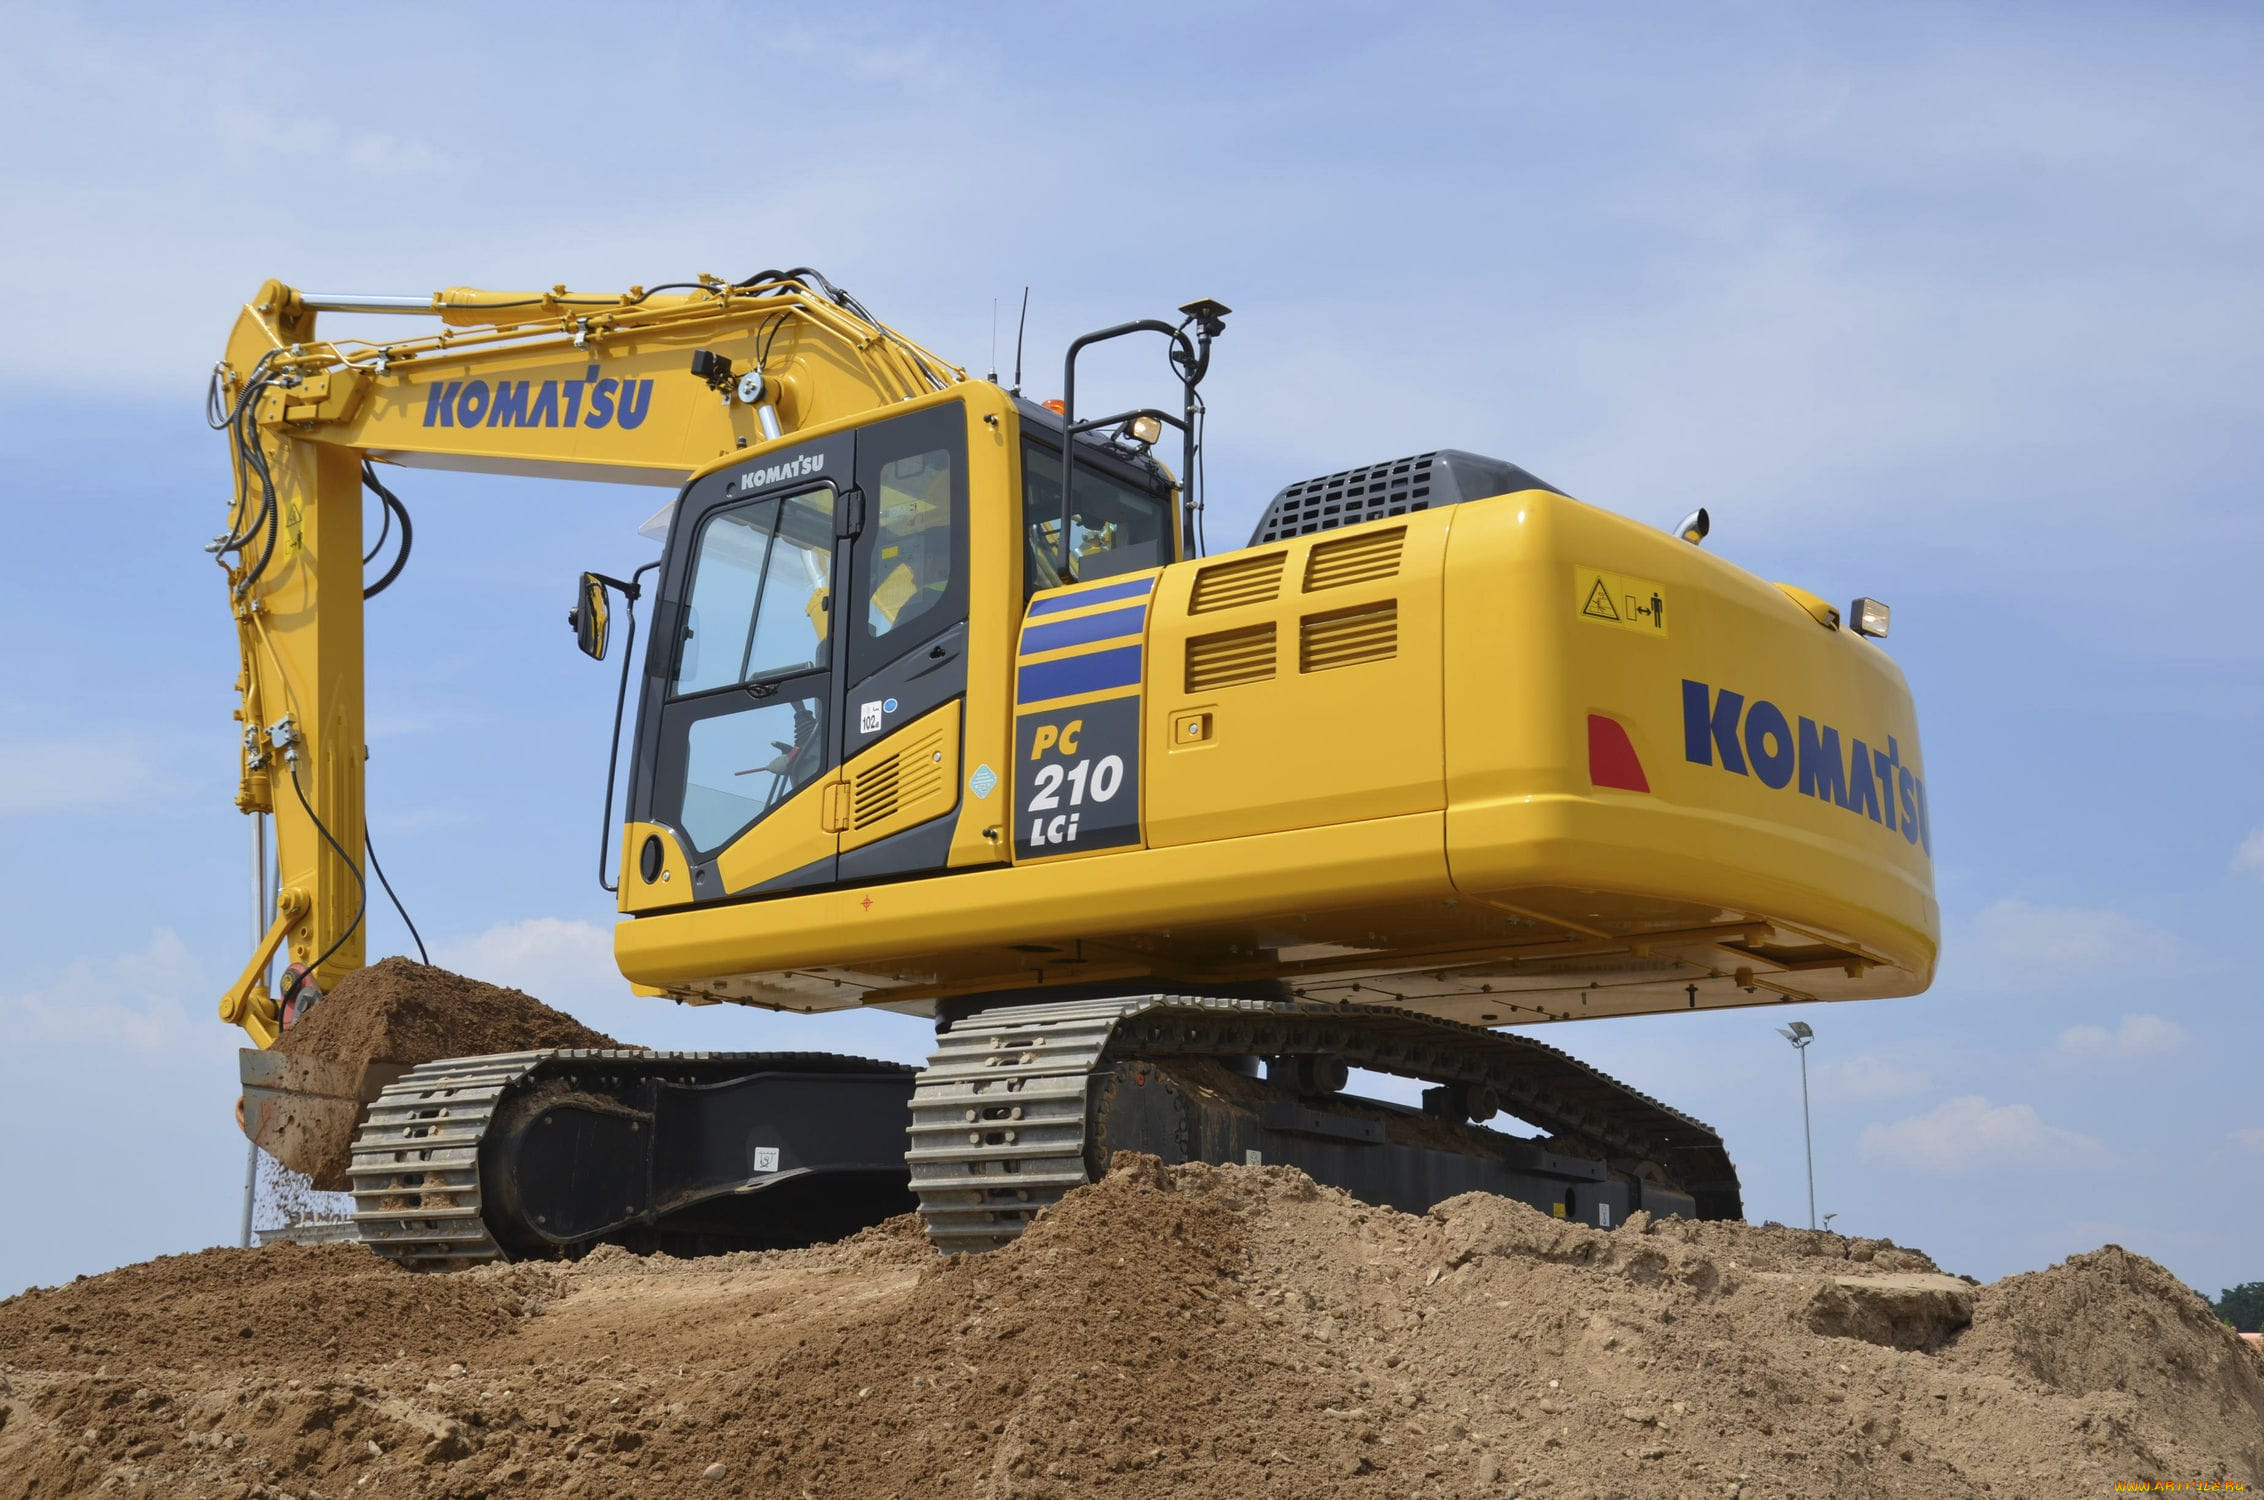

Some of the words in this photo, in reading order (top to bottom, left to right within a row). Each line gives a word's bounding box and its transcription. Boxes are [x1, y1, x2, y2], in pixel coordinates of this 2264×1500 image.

[422, 364, 655, 430] KOMATSU
[741, 453, 824, 490] KOMATSU
[1030, 719, 1083, 760] PC
[1028, 754, 1124, 812] 210
[1681, 678, 1931, 860] KOMATSU
[1030, 812, 1081, 846] LCi
